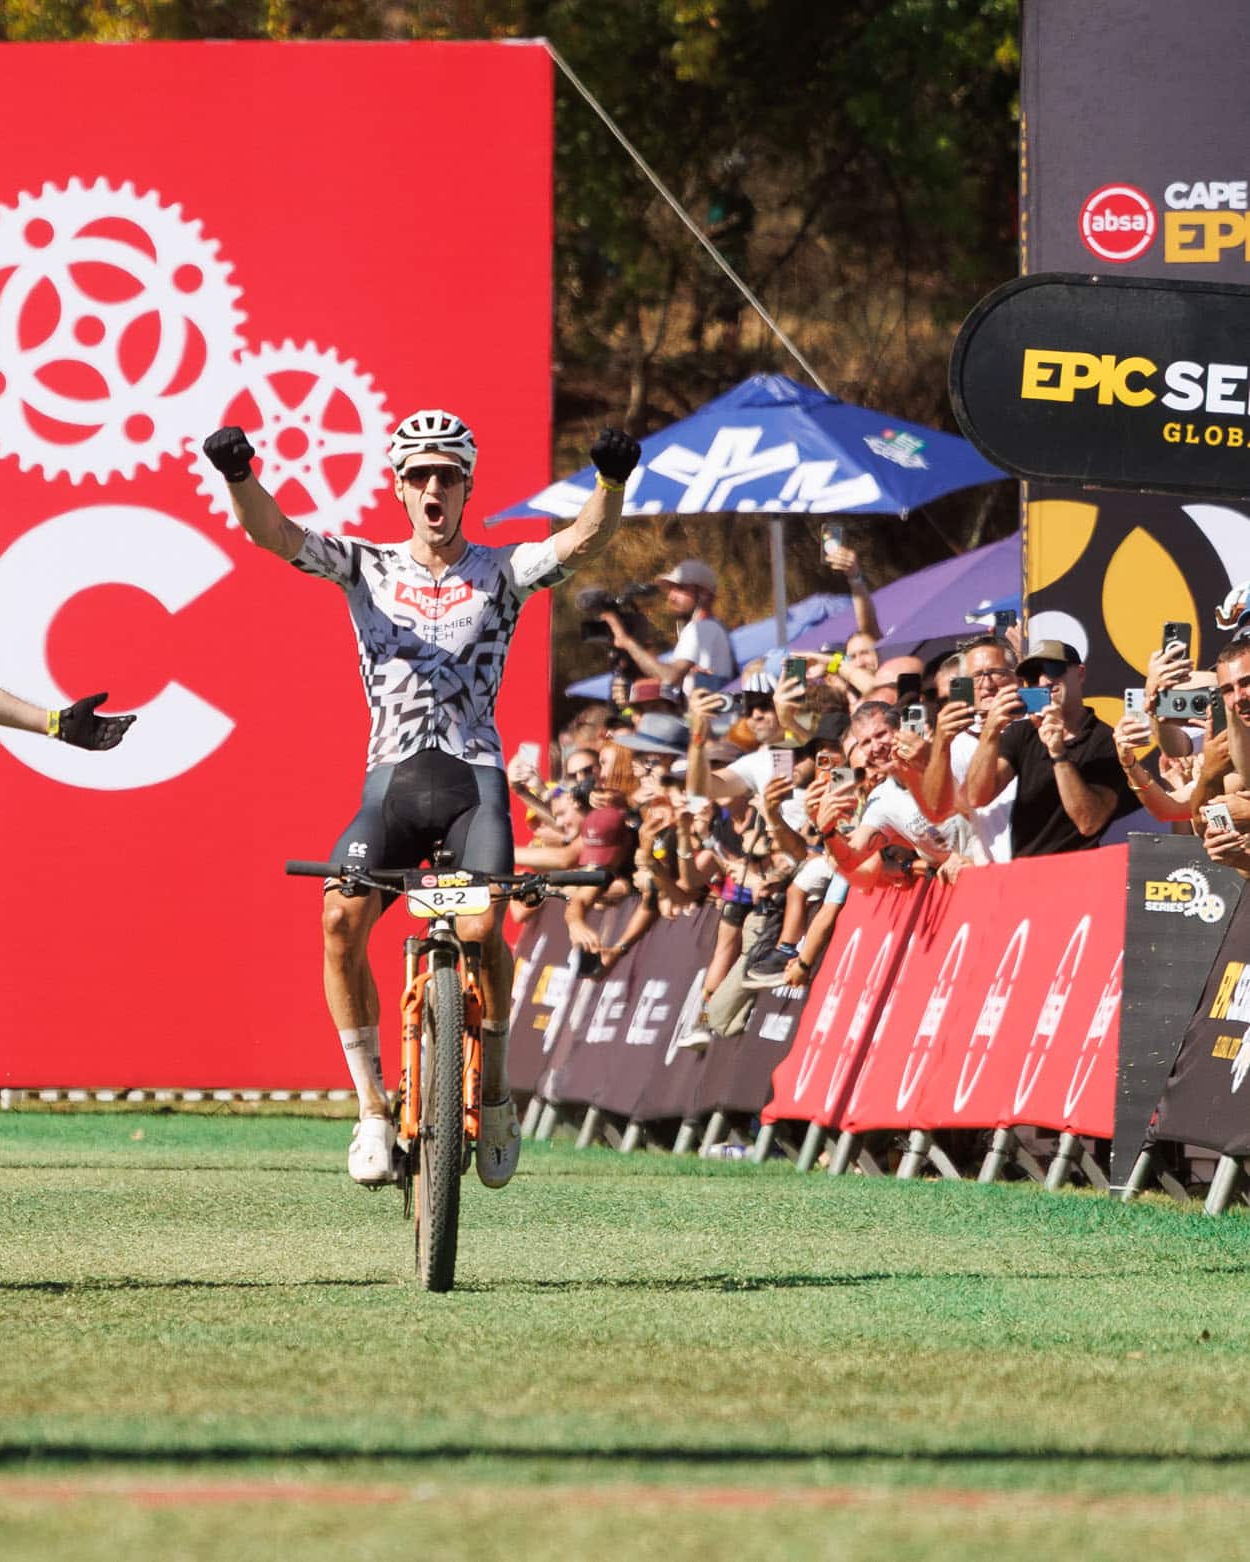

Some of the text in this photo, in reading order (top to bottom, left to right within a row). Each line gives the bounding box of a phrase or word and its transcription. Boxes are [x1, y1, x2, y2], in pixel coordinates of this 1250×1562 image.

[1164, 181, 1248, 210] CAPE
[1092, 208, 1146, 232] absa
[1021, 348, 1250, 416] EPIC SE
[1162, 421, 1250, 448] GLOB
[433, 892, 467, 905] 8-2
[1145, 881, 1193, 902] EPIC
[1145, 901, 1185, 913] SERIES
